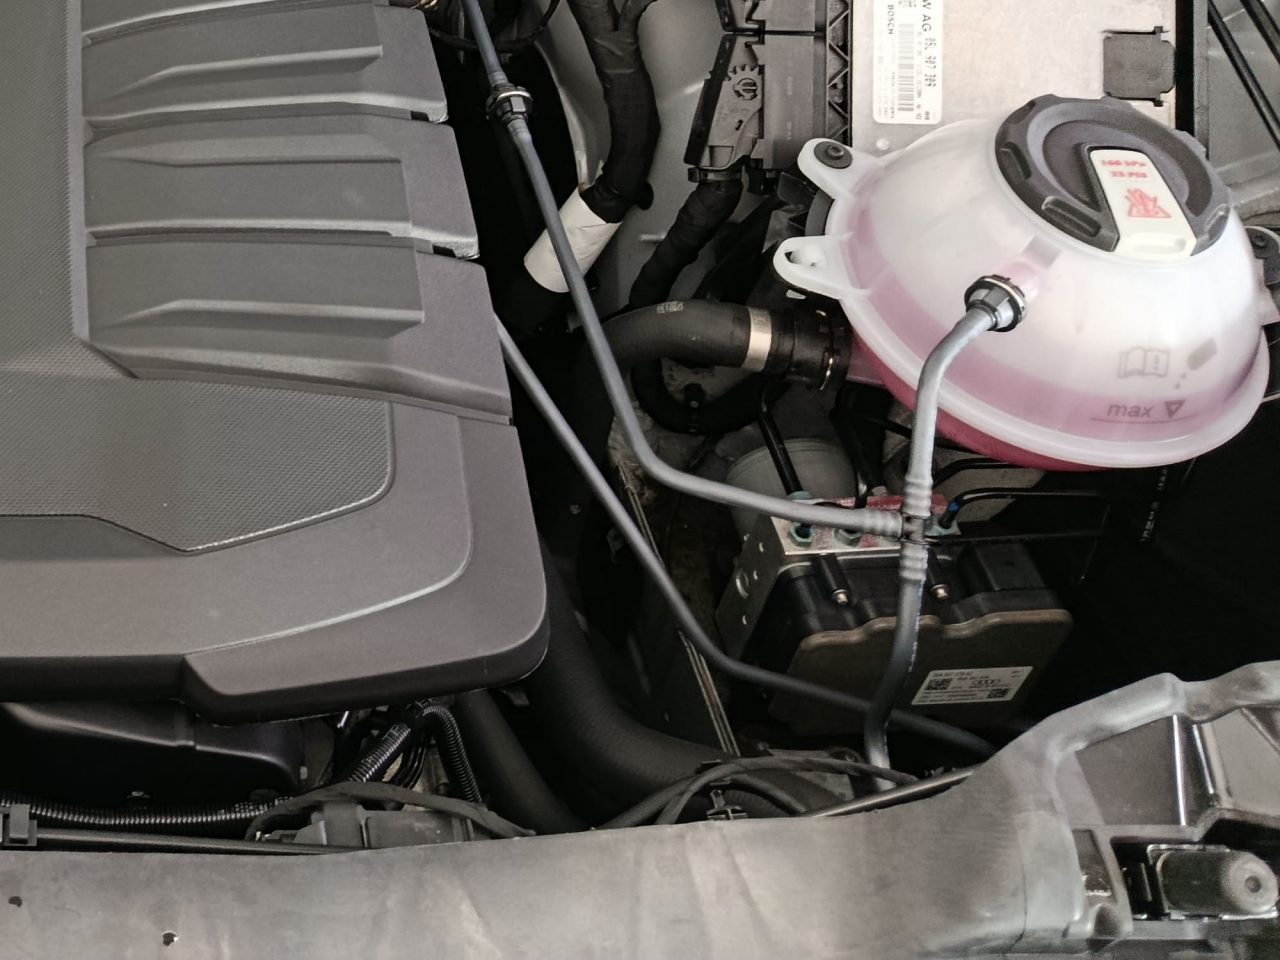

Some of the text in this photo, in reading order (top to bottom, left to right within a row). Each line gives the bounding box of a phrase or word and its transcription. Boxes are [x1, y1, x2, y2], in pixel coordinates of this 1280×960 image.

[887, 4, 895, 35] BOSCH
[921, 14, 932, 33] AG
[1106, 404, 1154, 418] max
